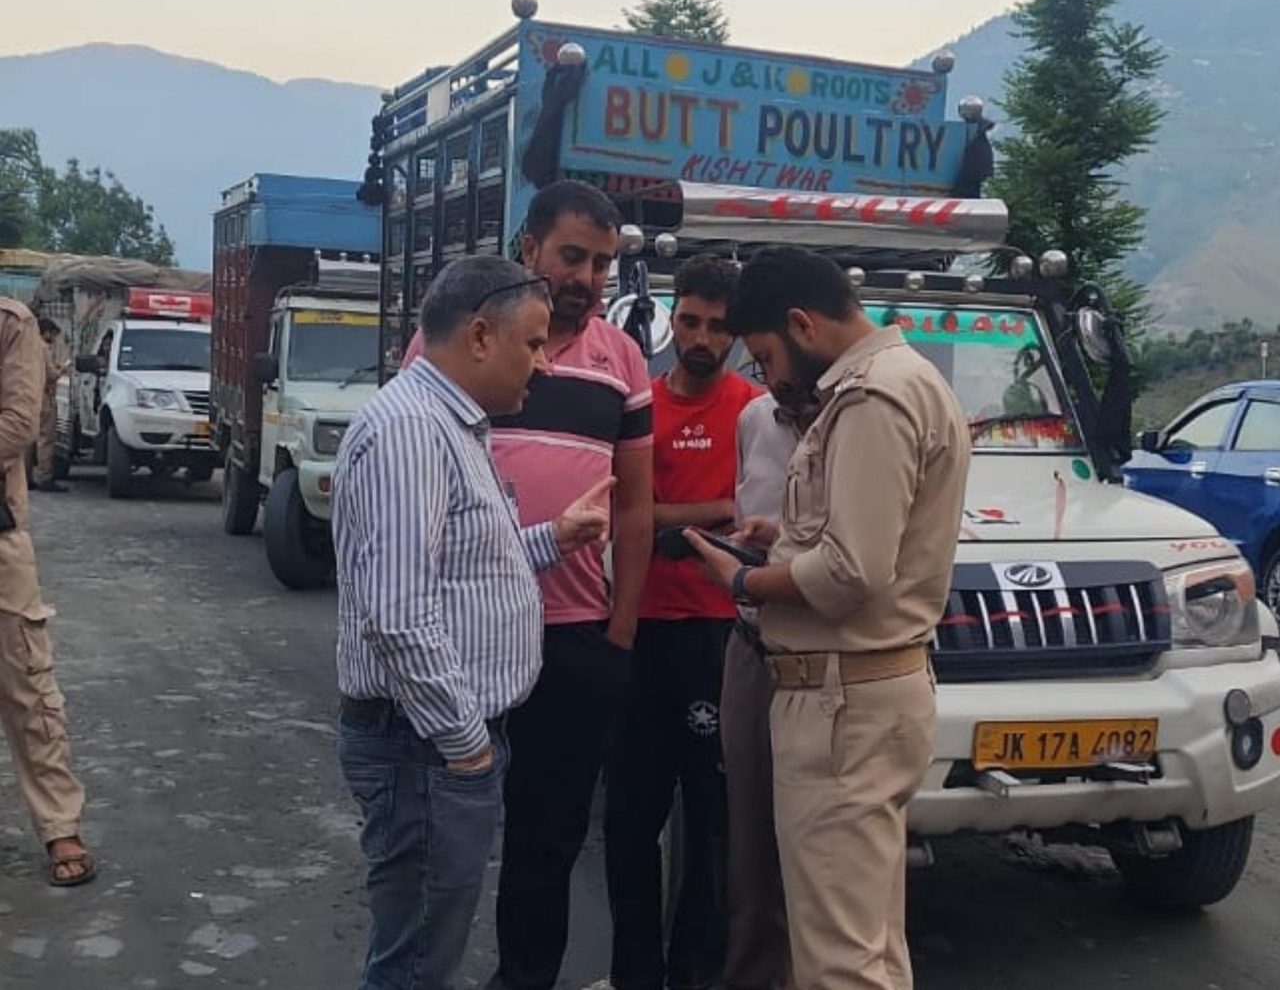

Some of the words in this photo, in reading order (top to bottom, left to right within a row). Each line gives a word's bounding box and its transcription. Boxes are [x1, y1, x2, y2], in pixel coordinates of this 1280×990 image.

[593, 43, 659, 79] ALL
[808, 71, 892, 105] ROOTS
[605, 85, 740, 151] BUTT
[757, 102, 946, 173] POULTRY
[994, 732, 1026, 761] JK
[1037, 731, 1081, 761] 17A
